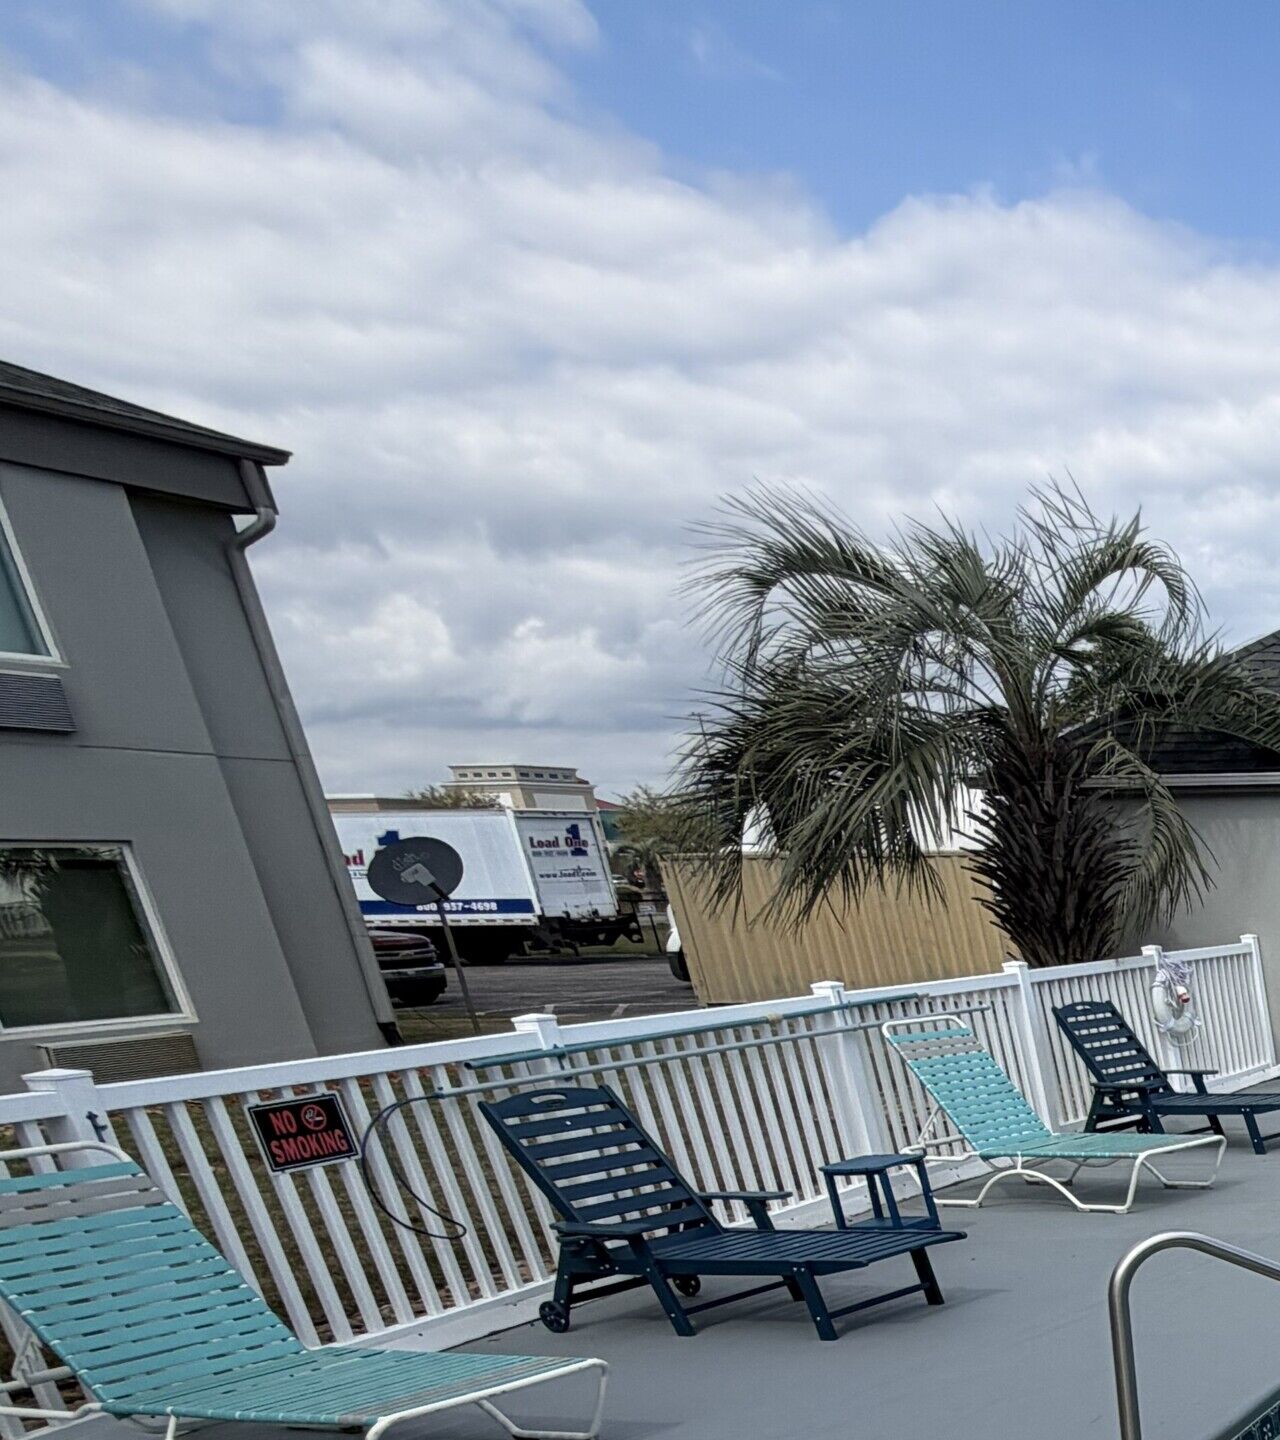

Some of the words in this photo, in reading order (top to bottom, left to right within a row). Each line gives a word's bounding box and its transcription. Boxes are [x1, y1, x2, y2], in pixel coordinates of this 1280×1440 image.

[529, 836, 560, 849] Load
[564, 836, 589, 848] One
[269, 1110, 298, 1136] NO
[270, 1129, 349, 1163] SMOKING
